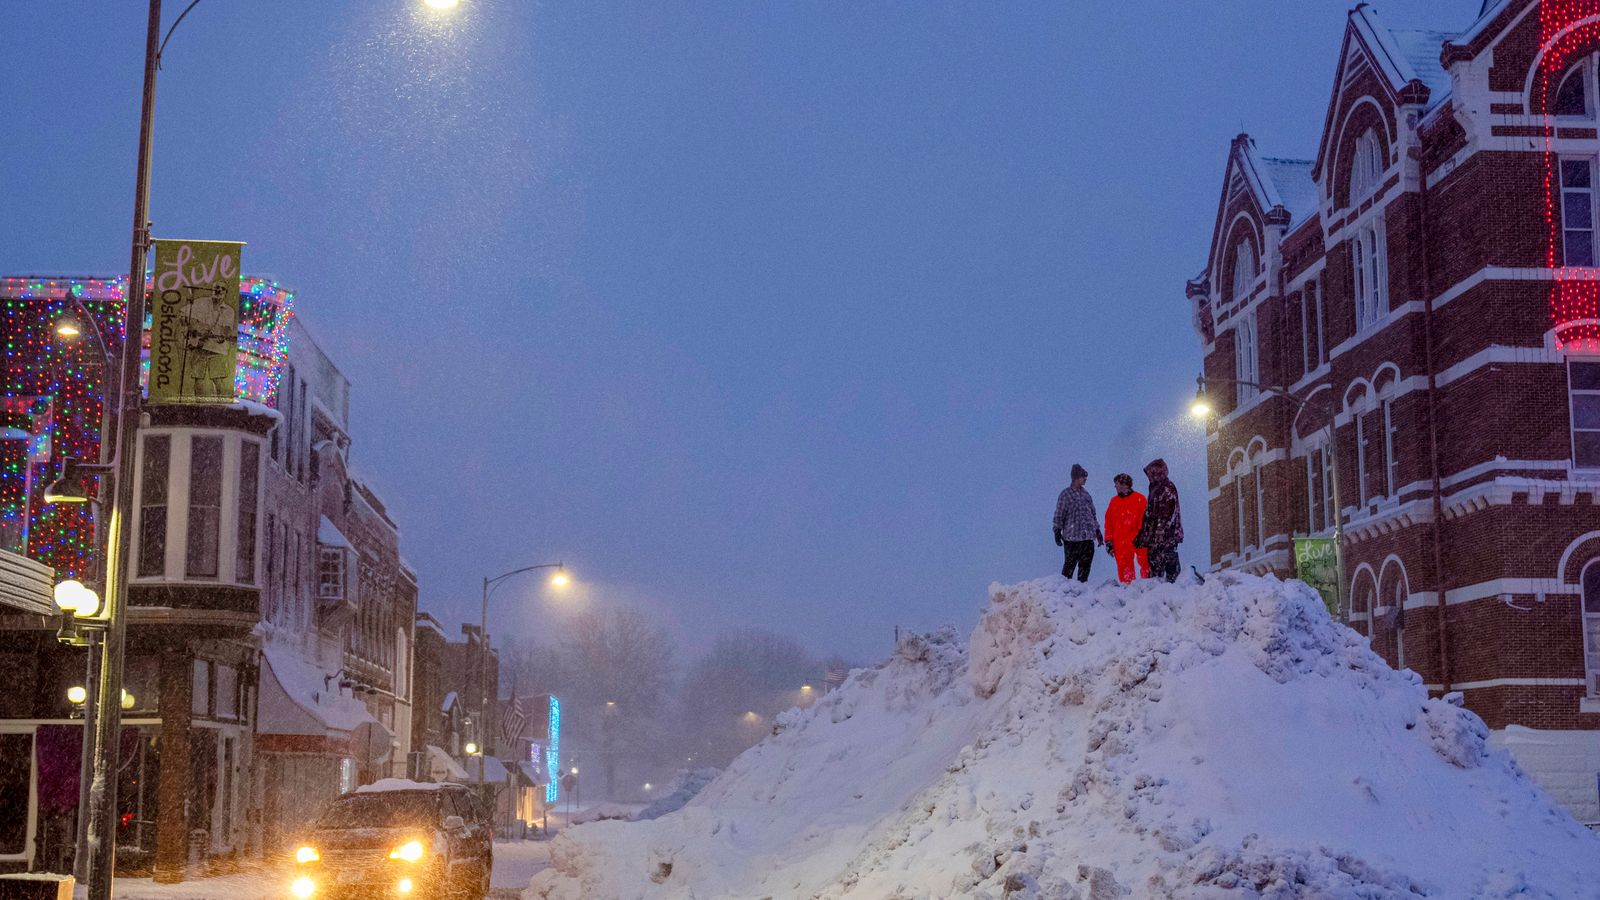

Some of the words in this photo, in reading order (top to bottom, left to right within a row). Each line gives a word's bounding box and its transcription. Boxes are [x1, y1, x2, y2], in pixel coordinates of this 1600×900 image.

[158, 245, 236, 292] Live
[157, 289, 182, 389] Oskaloosa
[1299, 541, 1333, 562] Live
